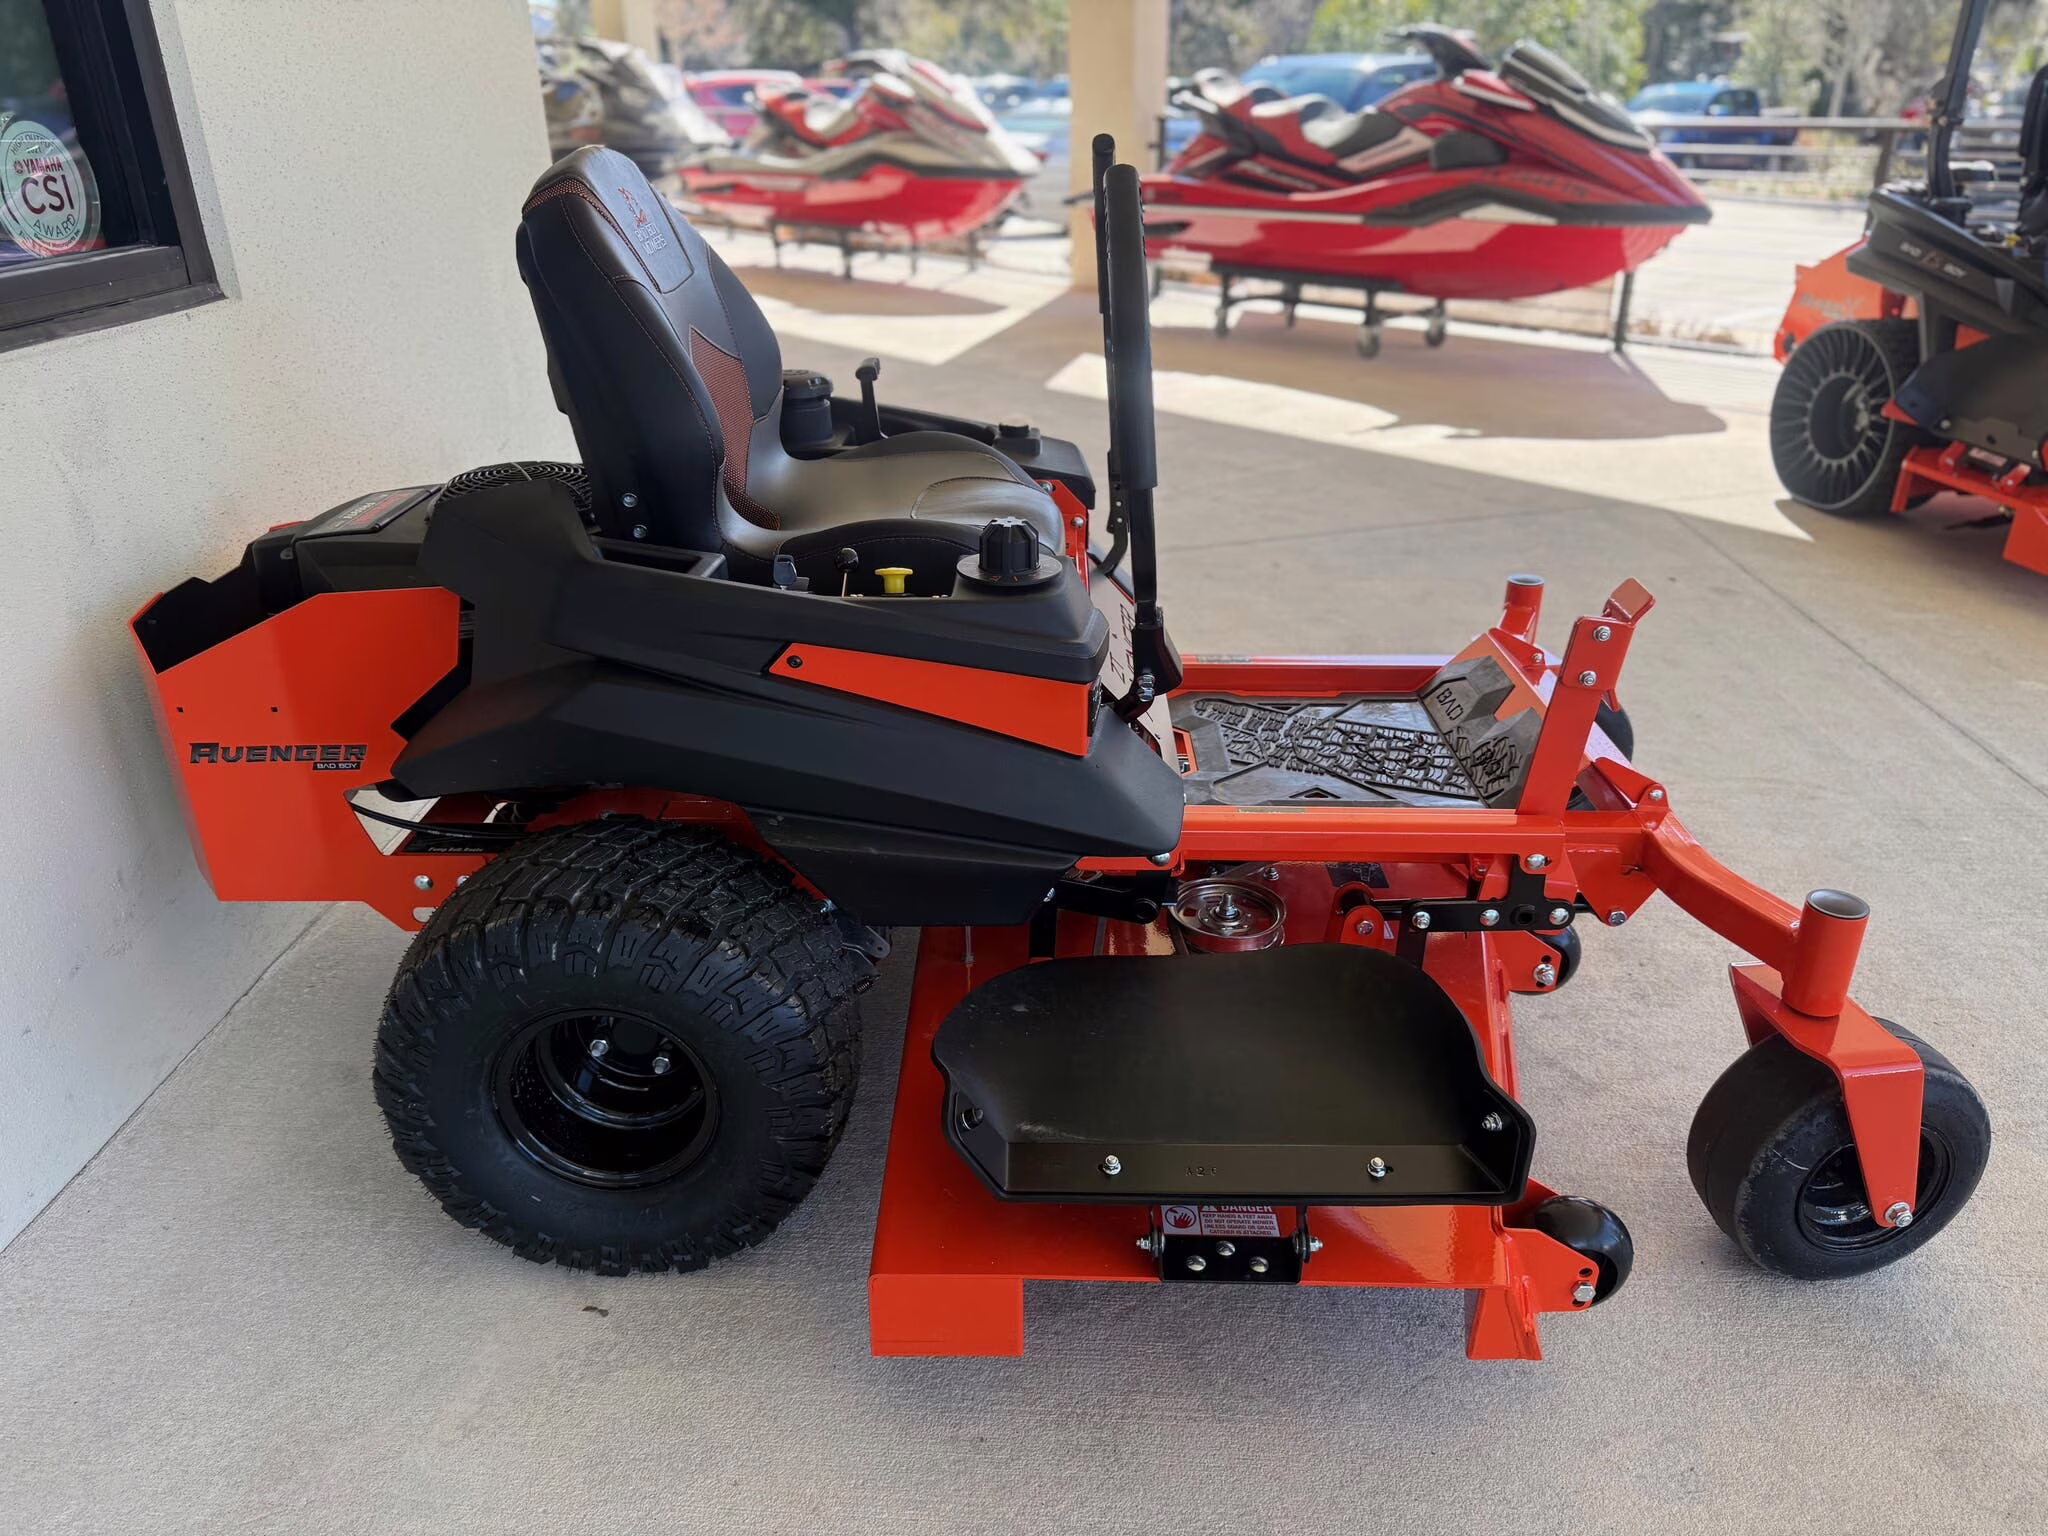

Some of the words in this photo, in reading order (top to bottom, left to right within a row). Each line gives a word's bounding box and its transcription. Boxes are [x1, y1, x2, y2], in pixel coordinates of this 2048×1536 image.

[23, 156, 64, 174] YAMAHA
[21, 174, 75, 215] CSI
[32, 213, 76, 238] AWARD
[1436, 687, 1464, 721] BAD
[189, 742, 368, 764] AVENGER
[1221, 1205, 1273, 1213] DANGER
